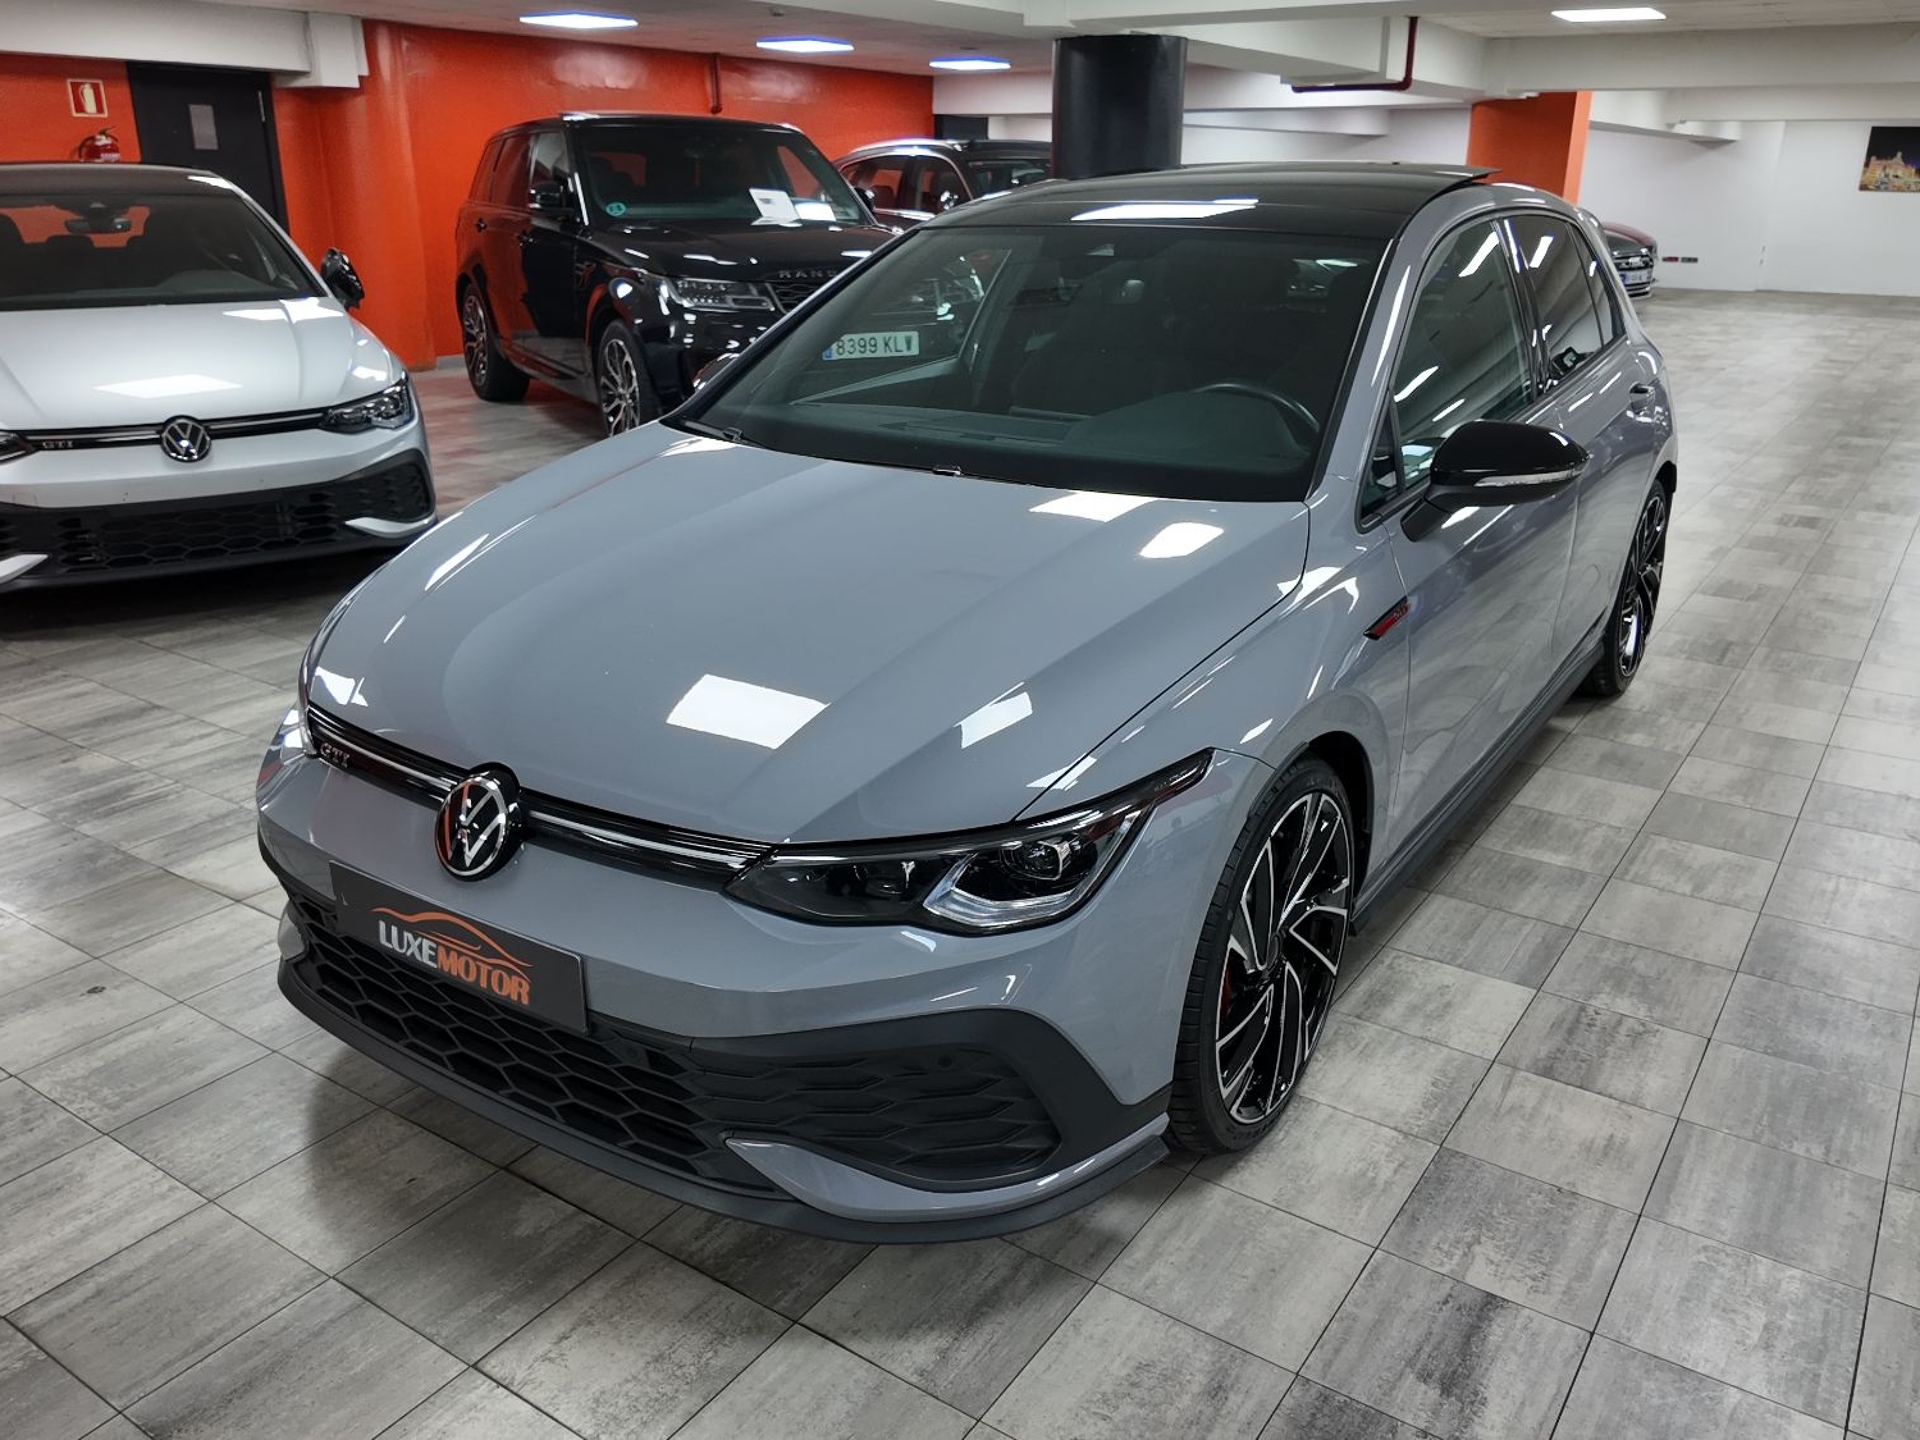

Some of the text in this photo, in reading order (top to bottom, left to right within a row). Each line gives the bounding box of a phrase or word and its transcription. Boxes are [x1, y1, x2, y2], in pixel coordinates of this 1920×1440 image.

[836, 337, 878, 355] 8399
[320, 742, 350, 769] GTI
[378, 919, 530, 1006] LUXEMOTOR
